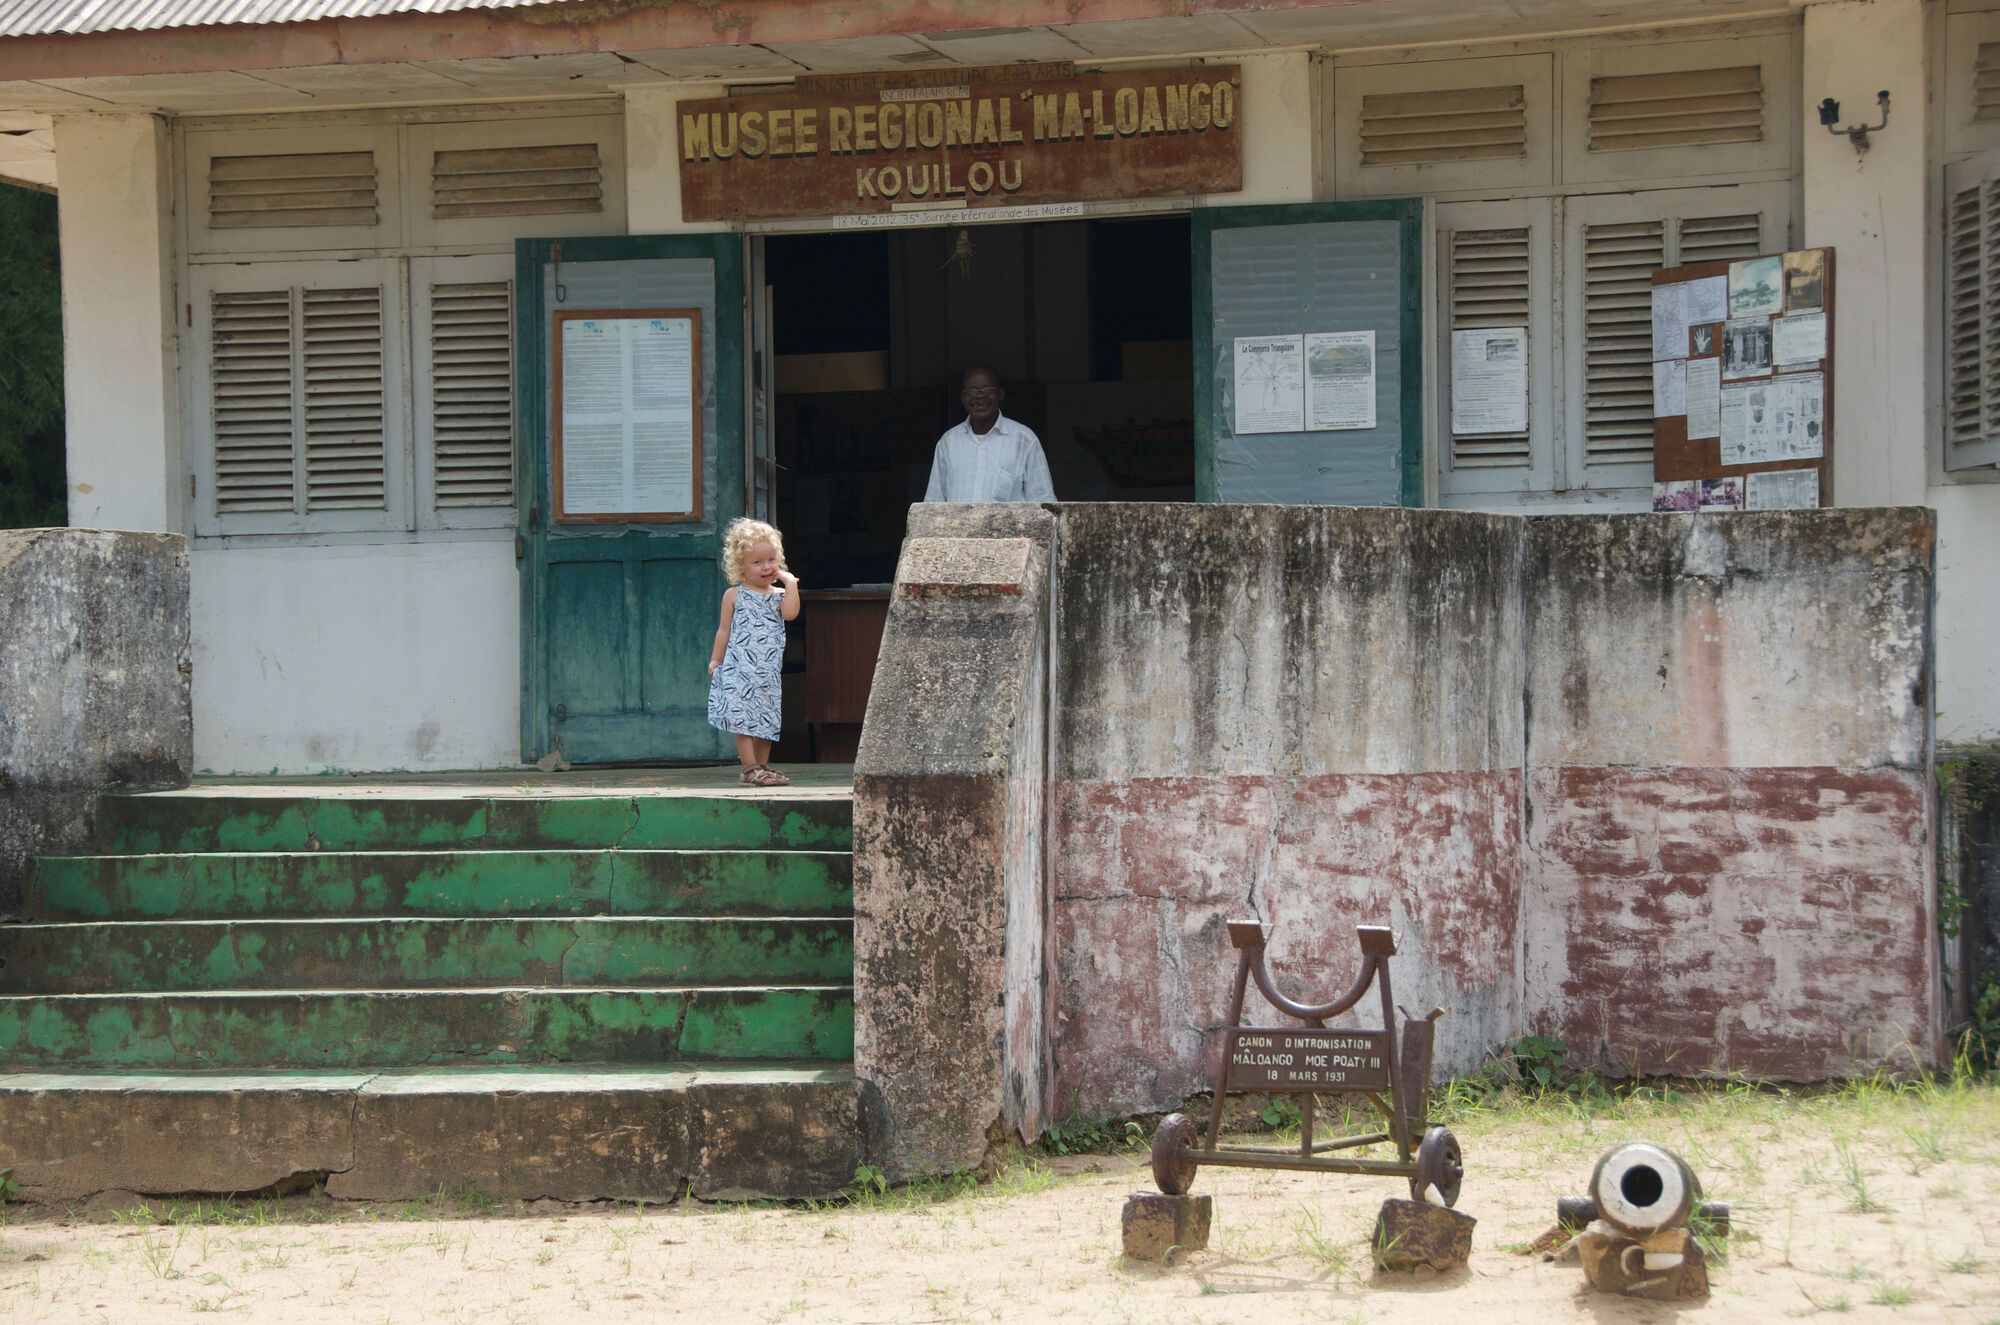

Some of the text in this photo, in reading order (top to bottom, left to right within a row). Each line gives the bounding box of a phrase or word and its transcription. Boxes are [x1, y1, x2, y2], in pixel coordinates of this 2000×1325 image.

[1036, 64, 1072, 80] ARTS
[682, 108, 817, 160] MUSEE
[829, 97, 1024, 153] REGIONAL
[856, 160, 1022, 197] KOUILOU
[838, 215, 848, 228] 18
[872, 213, 897, 226] 2012
[961, 208, 1022, 221] Internationale
[1024, 207, 1039, 217] des
[1041, 204, 1079, 216] Musées
[1238, 1036, 1272, 1048] CANON
[1305, 1055, 1328, 1067] MOE
[1333, 1055, 1366, 1068] POATY
[1370, 1057, 1381, 1069] III
[1267, 1069, 1346, 1082] 18 MARS 1931
